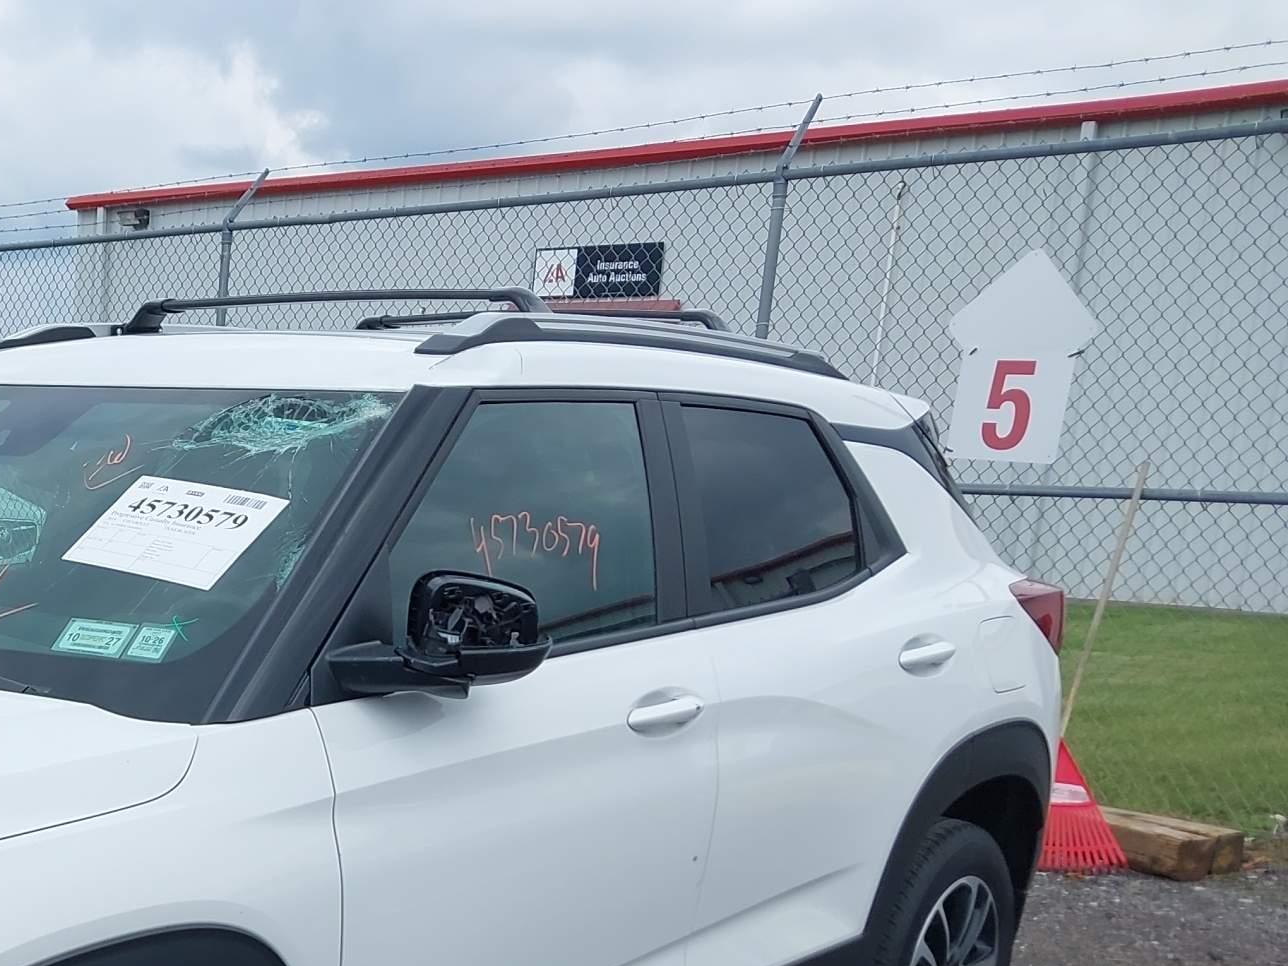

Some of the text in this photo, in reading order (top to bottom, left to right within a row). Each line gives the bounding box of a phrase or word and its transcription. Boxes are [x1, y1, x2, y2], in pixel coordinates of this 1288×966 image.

[588, 271, 647, 283] Auto Auctions
[597, 260, 639, 270] Insurance
[981, 360, 1037, 450] 5
[127, 496, 249, 530] 45730579
[470, 511, 600, 592] 45730579
[66, 632, 81, 642] 10
[105, 636, 121, 646] 27
